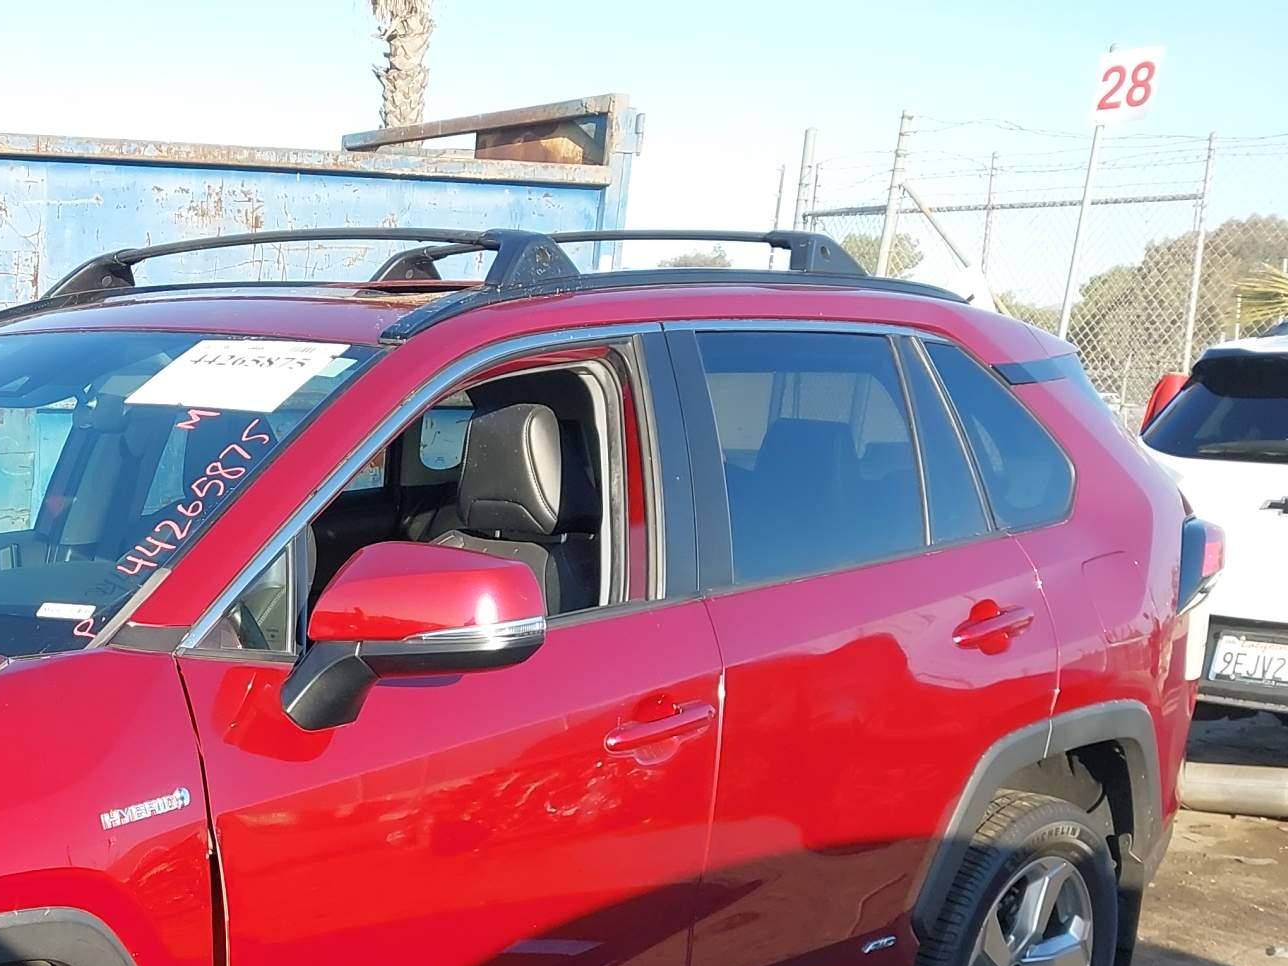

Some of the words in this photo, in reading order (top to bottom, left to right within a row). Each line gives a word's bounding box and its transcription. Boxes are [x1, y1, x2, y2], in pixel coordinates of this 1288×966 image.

[1097, 61, 1155, 110] 28
[190, 354, 312, 370] 44265875
[117, 419, 270, 575] 44265875
[100, 793, 181, 830] HYBRID
